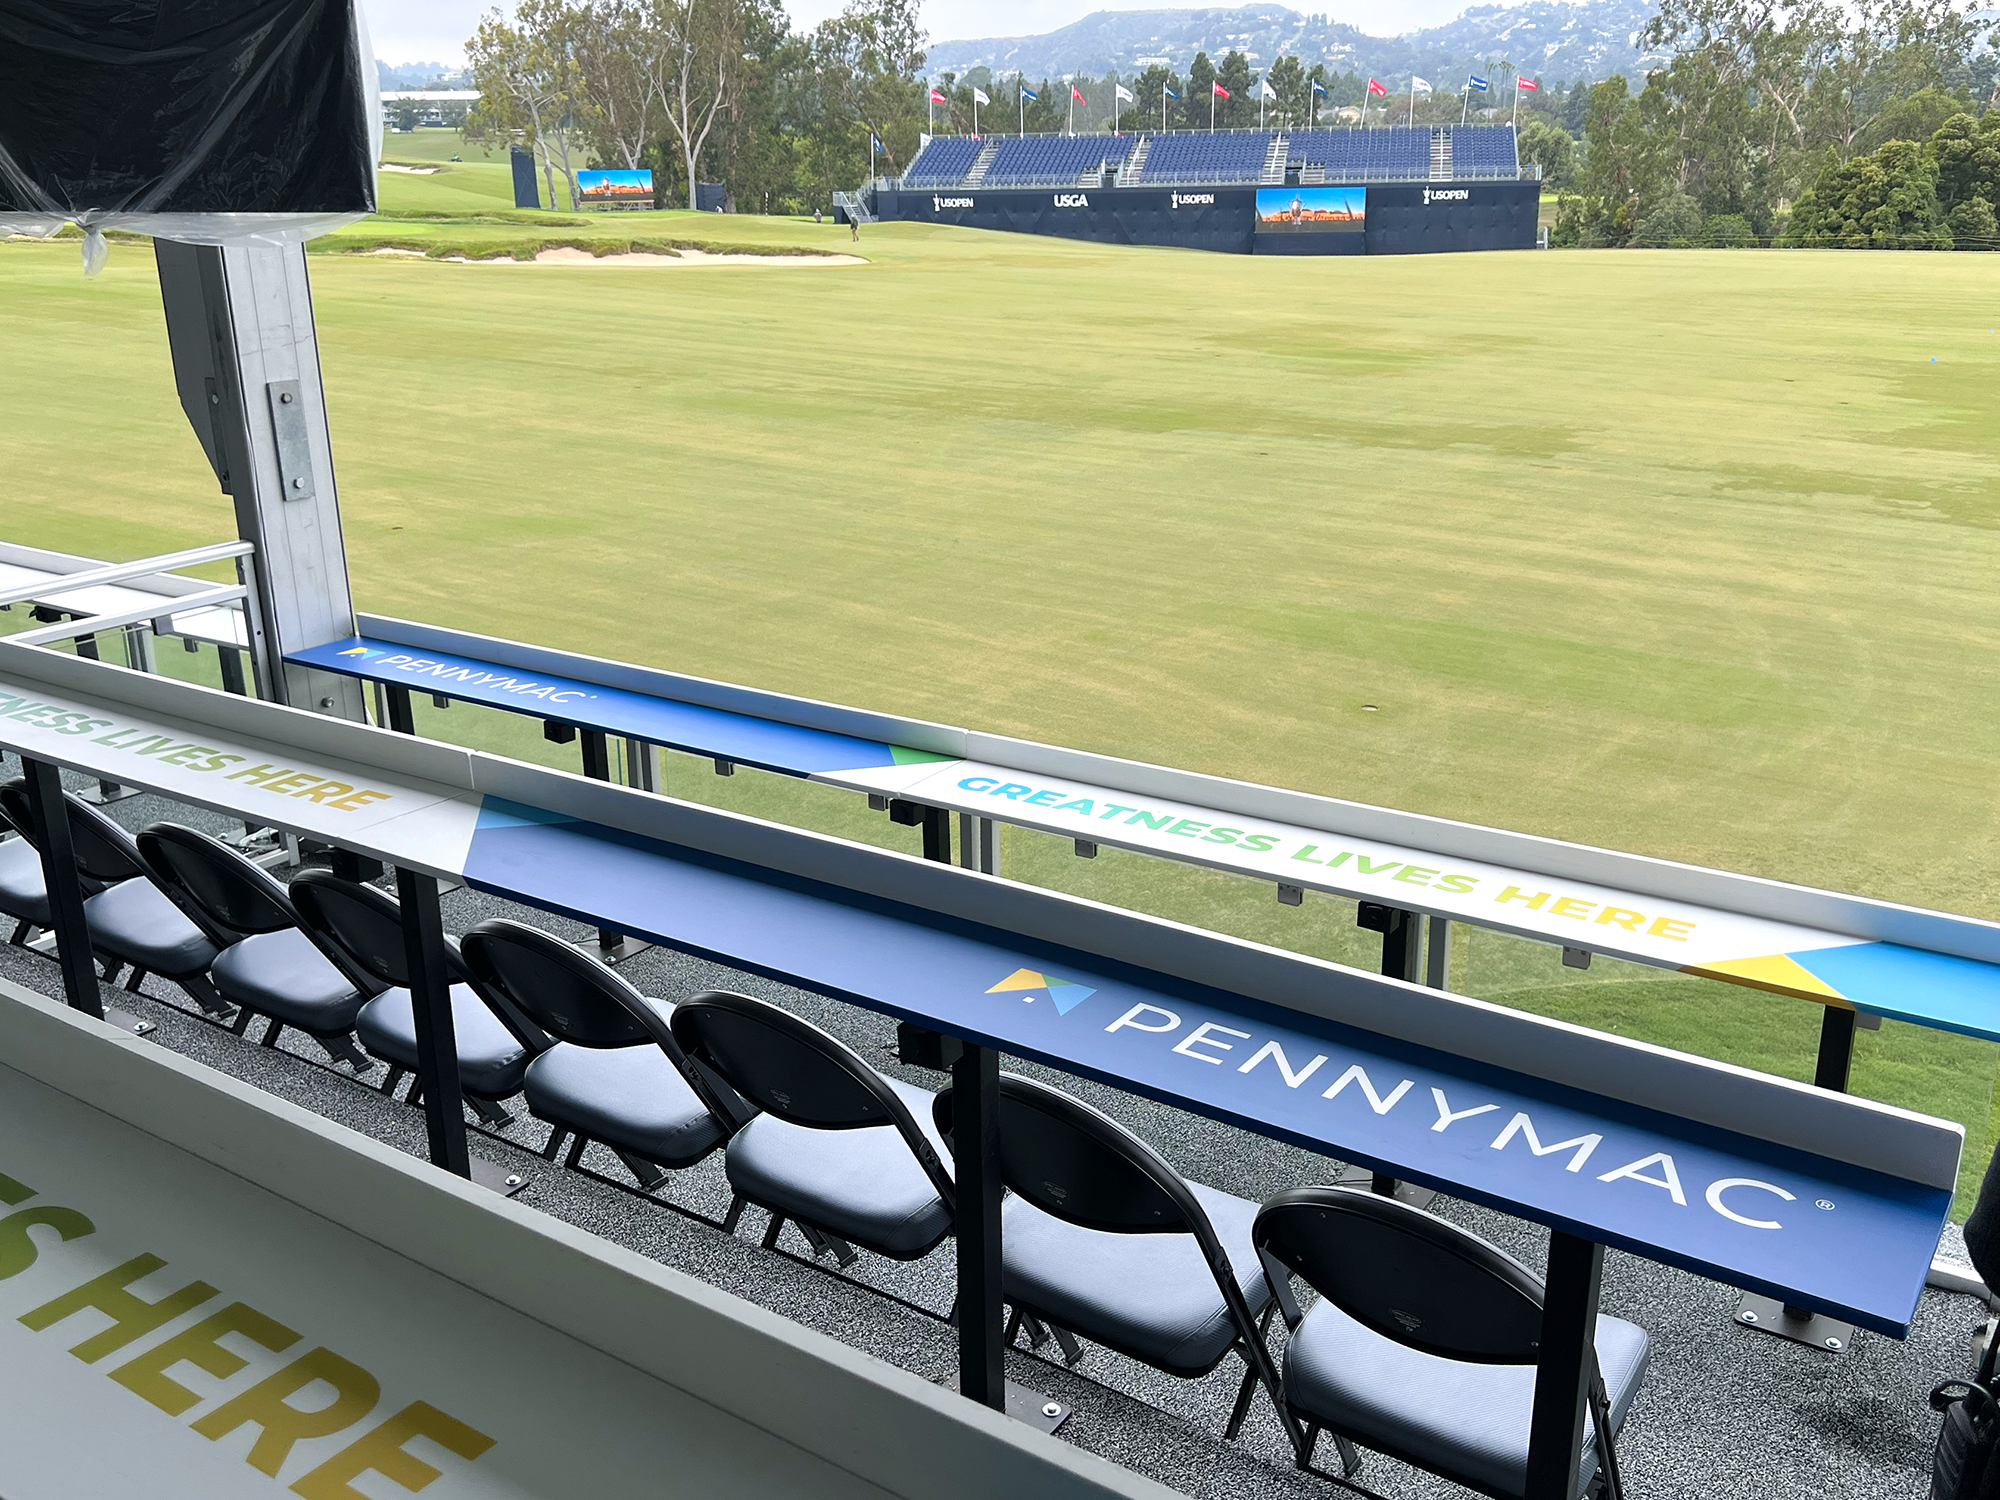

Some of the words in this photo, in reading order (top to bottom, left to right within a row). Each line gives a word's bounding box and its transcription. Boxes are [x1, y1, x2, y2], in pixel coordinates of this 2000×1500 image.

[1053, 194, 1089, 207] USGA
[375, 655, 587, 703] PENNYMAC
[90, 728, 248, 772] LIVES
[224, 763, 393, 812] HERE
[957, 775, 1282, 852] GREATNESS
[1290, 845, 1485, 894] LIVES
[1494, 884, 1699, 942] HERE
[1103, 1002, 1798, 1231] PENNYMAC
[16, 1252, 498, 1500] HERE
